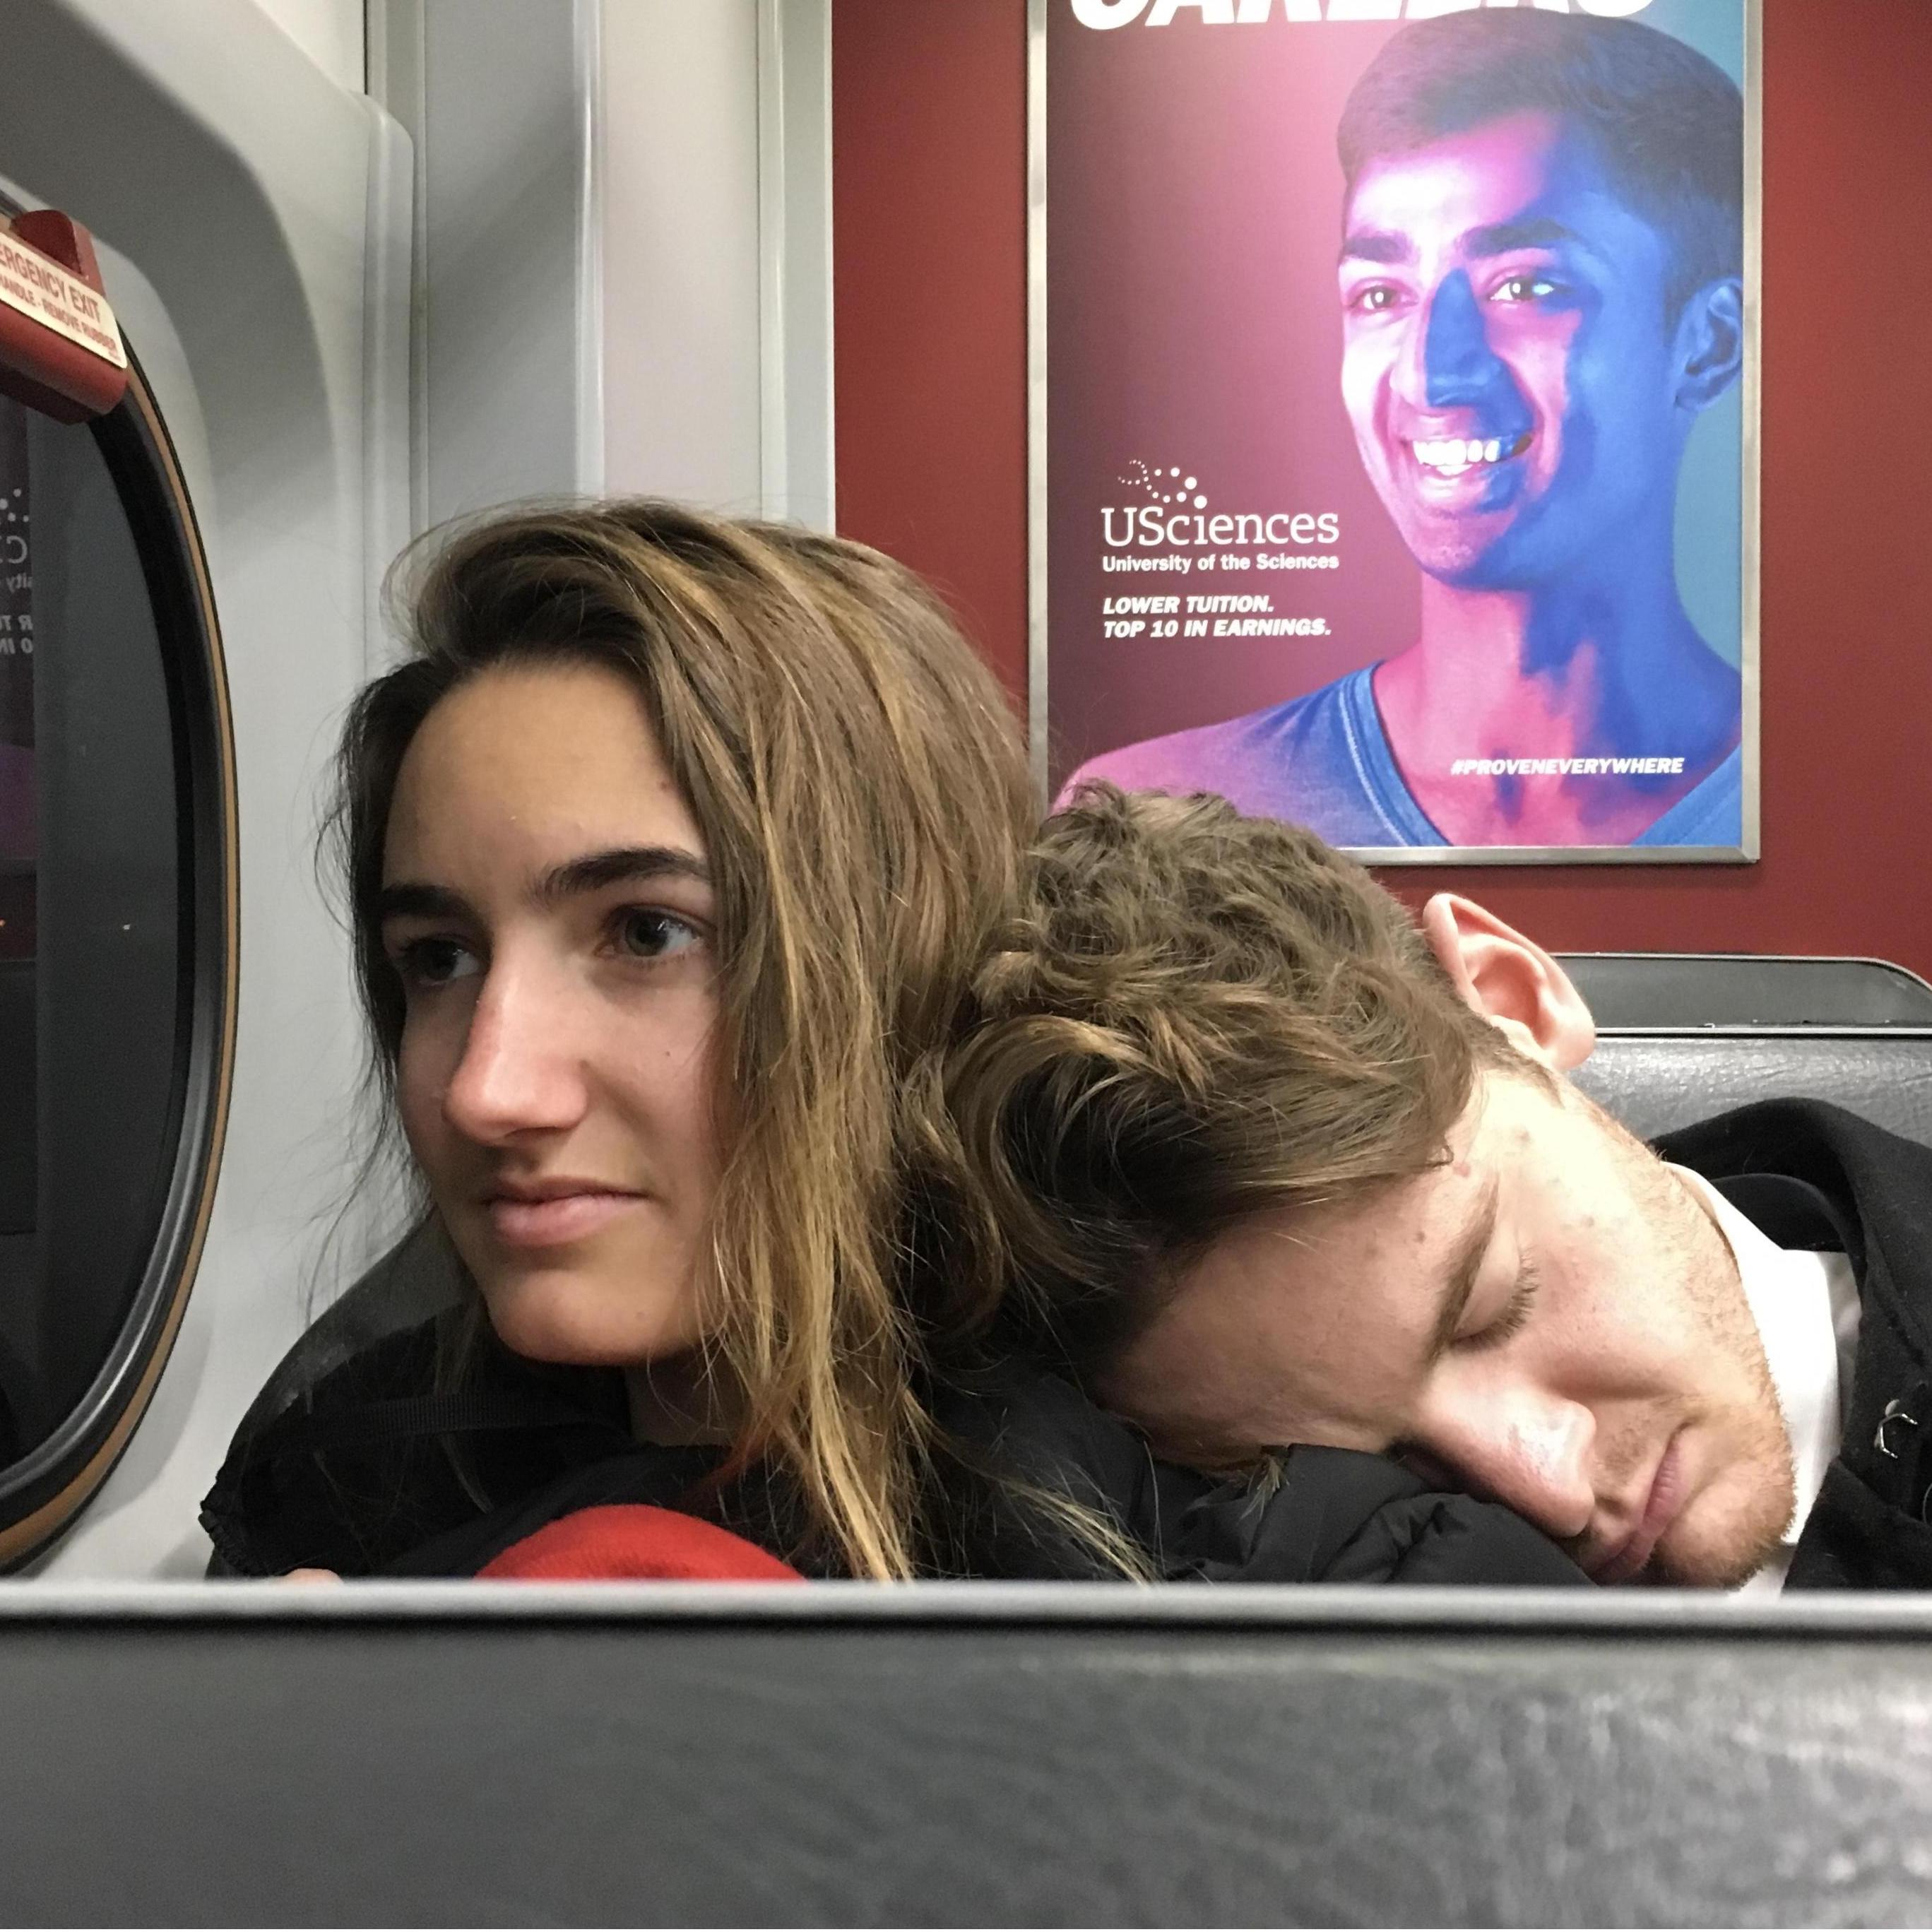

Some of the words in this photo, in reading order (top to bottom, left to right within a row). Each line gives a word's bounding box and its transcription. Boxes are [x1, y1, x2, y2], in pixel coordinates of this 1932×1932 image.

[69, 285, 101, 324] EXIT
[1101, 506, 1339, 547] USciences
[1103, 555, 1192, 574] University
[1197, 554, 1216, 571] of
[1220, 554, 1251, 570] the
[1256, 553, 1340, 570] Sciences
[1103, 597, 1180, 615] LOWER
[1186, 595, 1274, 613] TUITION.
[1104, 621, 1146, 638] TOP
[1150, 620, 1179, 637] 10
[1184, 620, 1209, 637] IN
[1213, 618, 1332, 636] EARNINGS.
[1450, 757, 1685, 776] #PROVENEVERYWHERE
